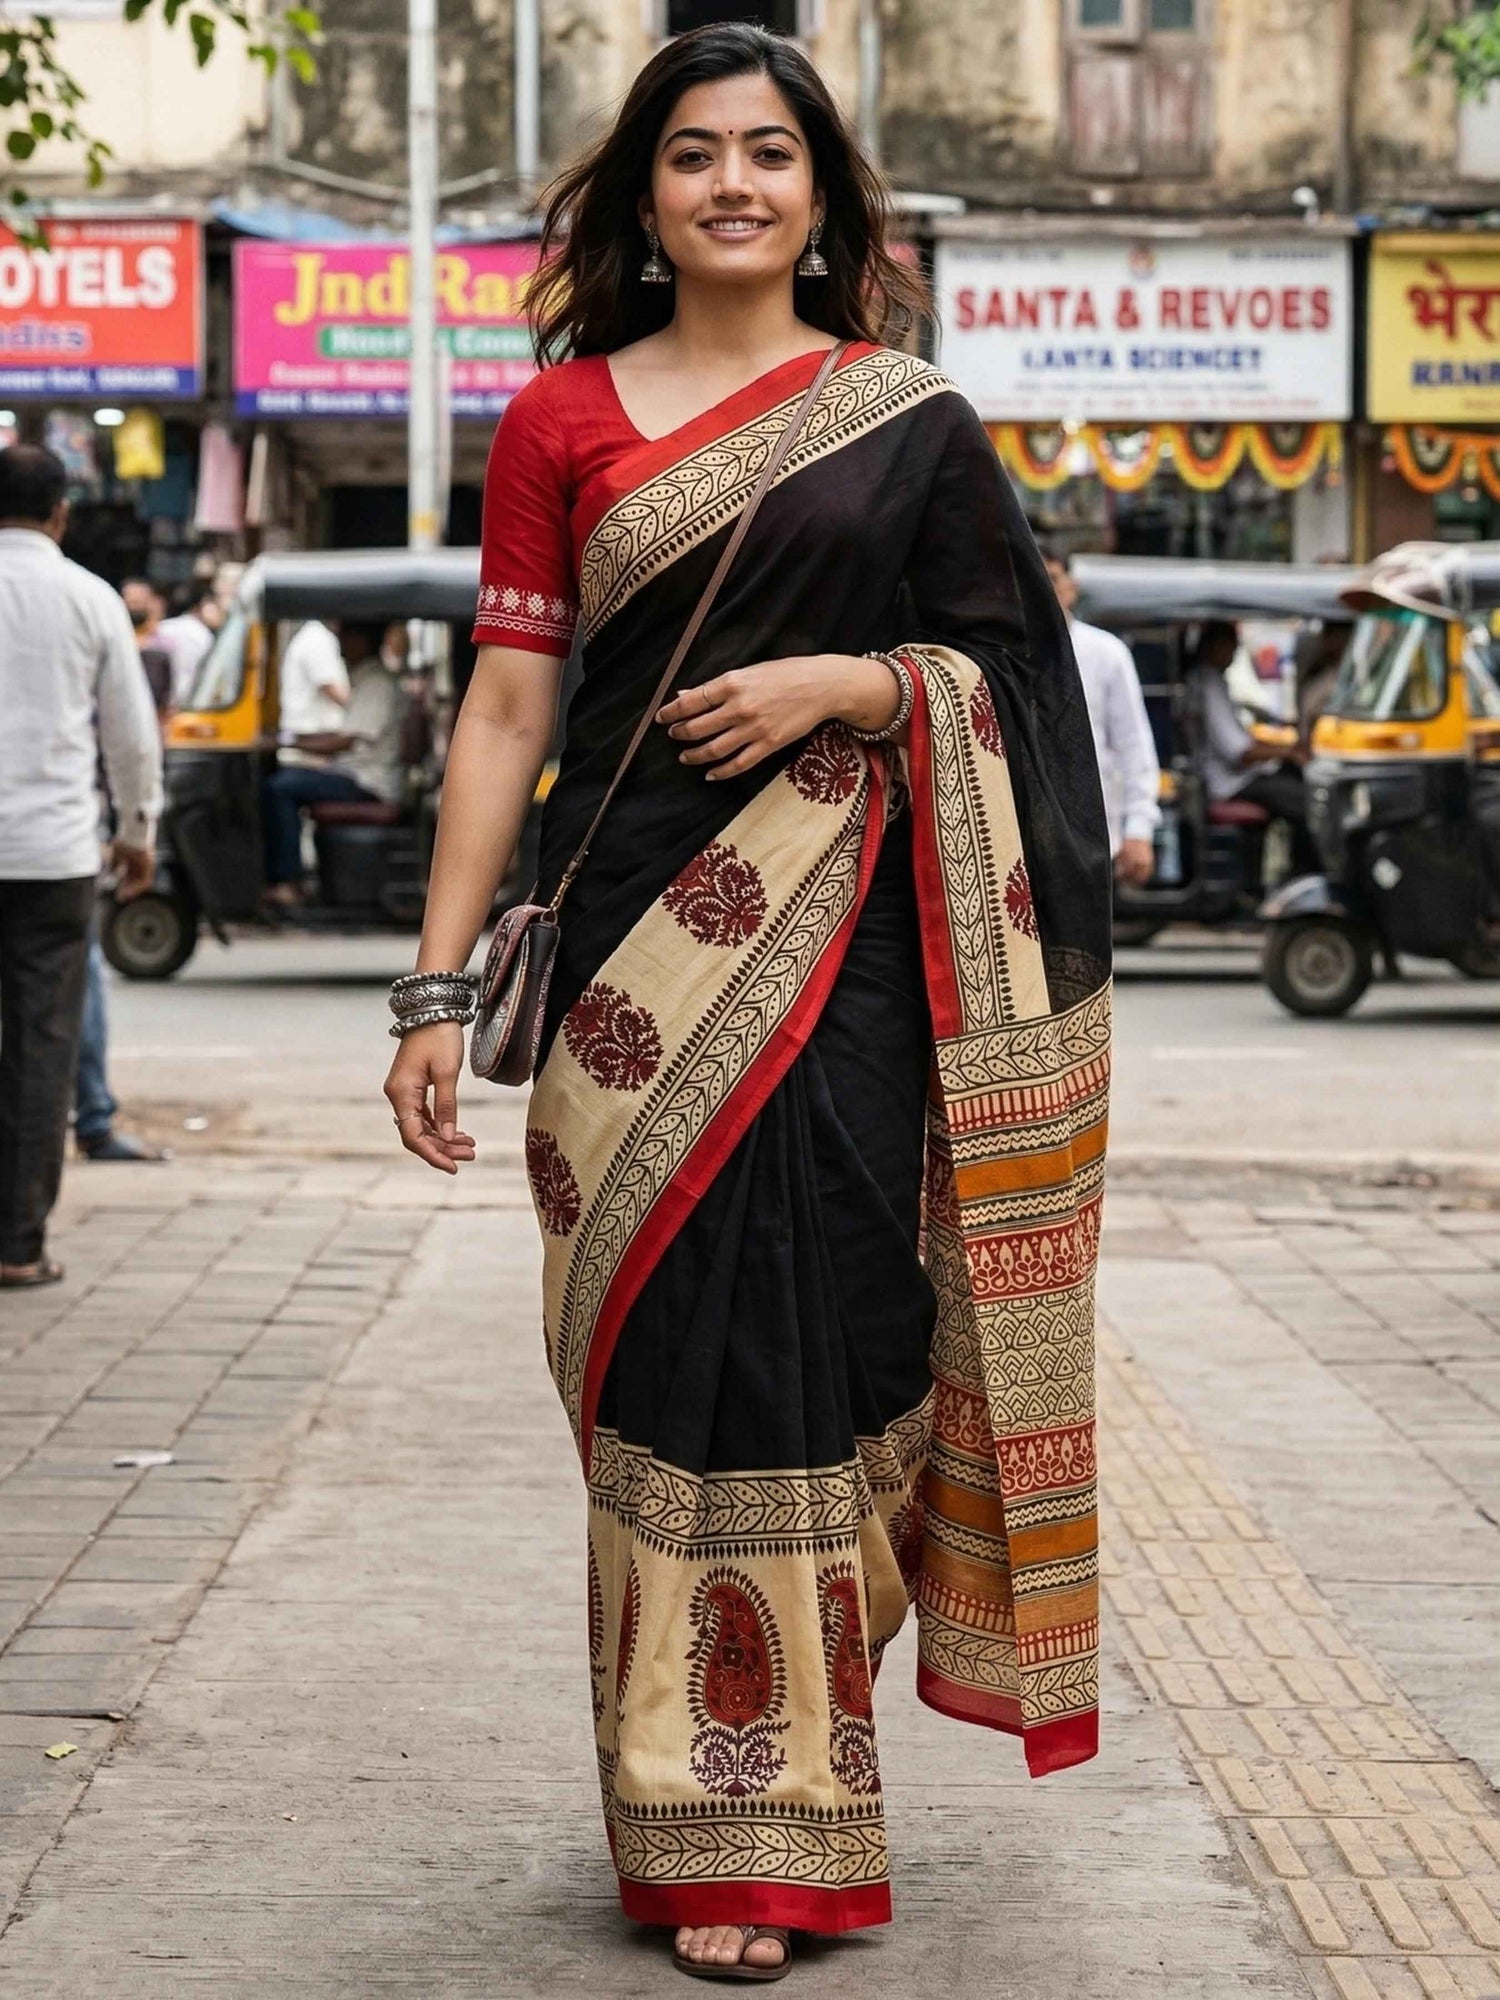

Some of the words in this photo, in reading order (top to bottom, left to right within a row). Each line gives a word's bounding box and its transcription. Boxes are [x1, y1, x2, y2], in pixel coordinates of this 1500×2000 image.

[956, 287, 1098, 331] SANTA
[1115, 287, 1141, 331] &
[1159, 286, 1331, 331] REVOES
